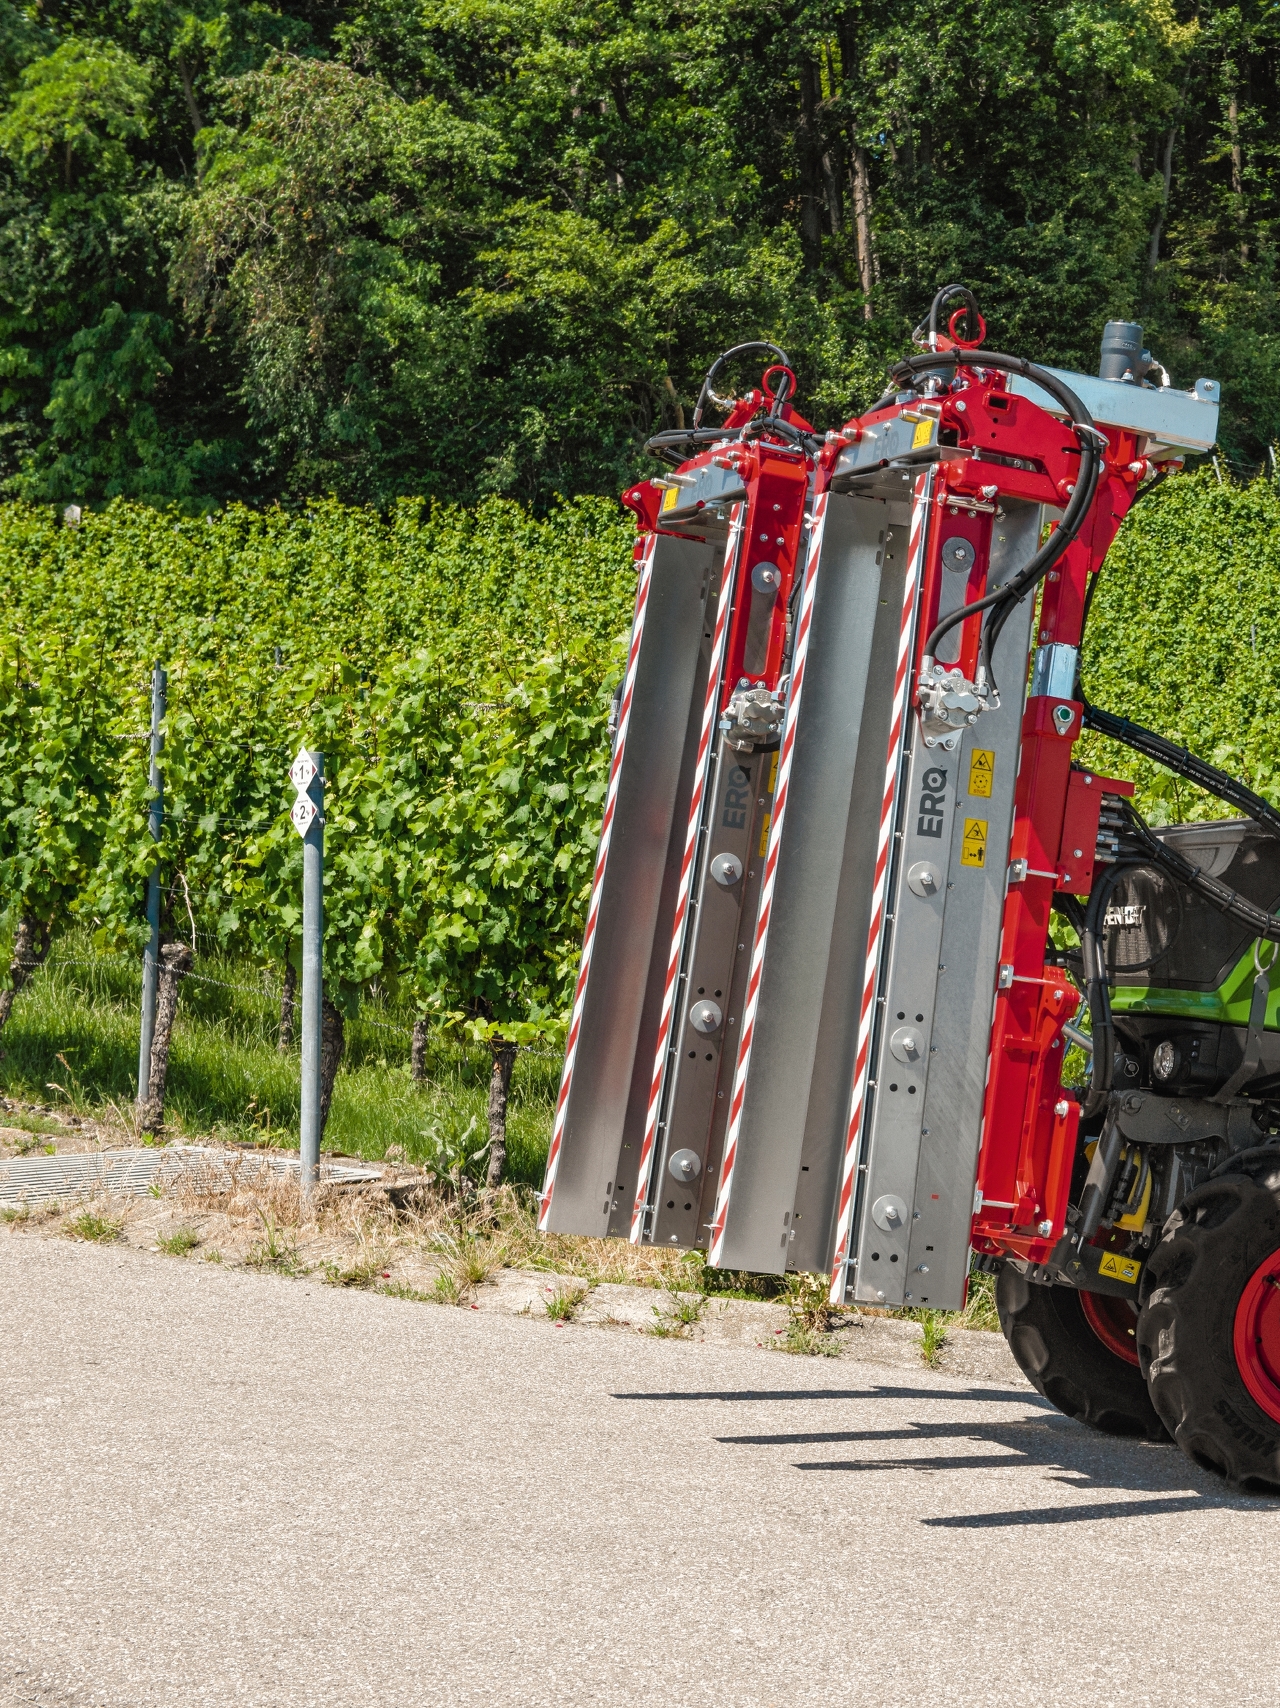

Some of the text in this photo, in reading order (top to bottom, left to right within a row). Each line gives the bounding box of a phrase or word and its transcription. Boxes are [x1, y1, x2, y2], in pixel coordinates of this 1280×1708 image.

[299, 765, 304, 780] 1
[300, 805, 306, 820] 2
[722, 764, 751, 830] ERO
[916, 766, 948, 839] ERO
